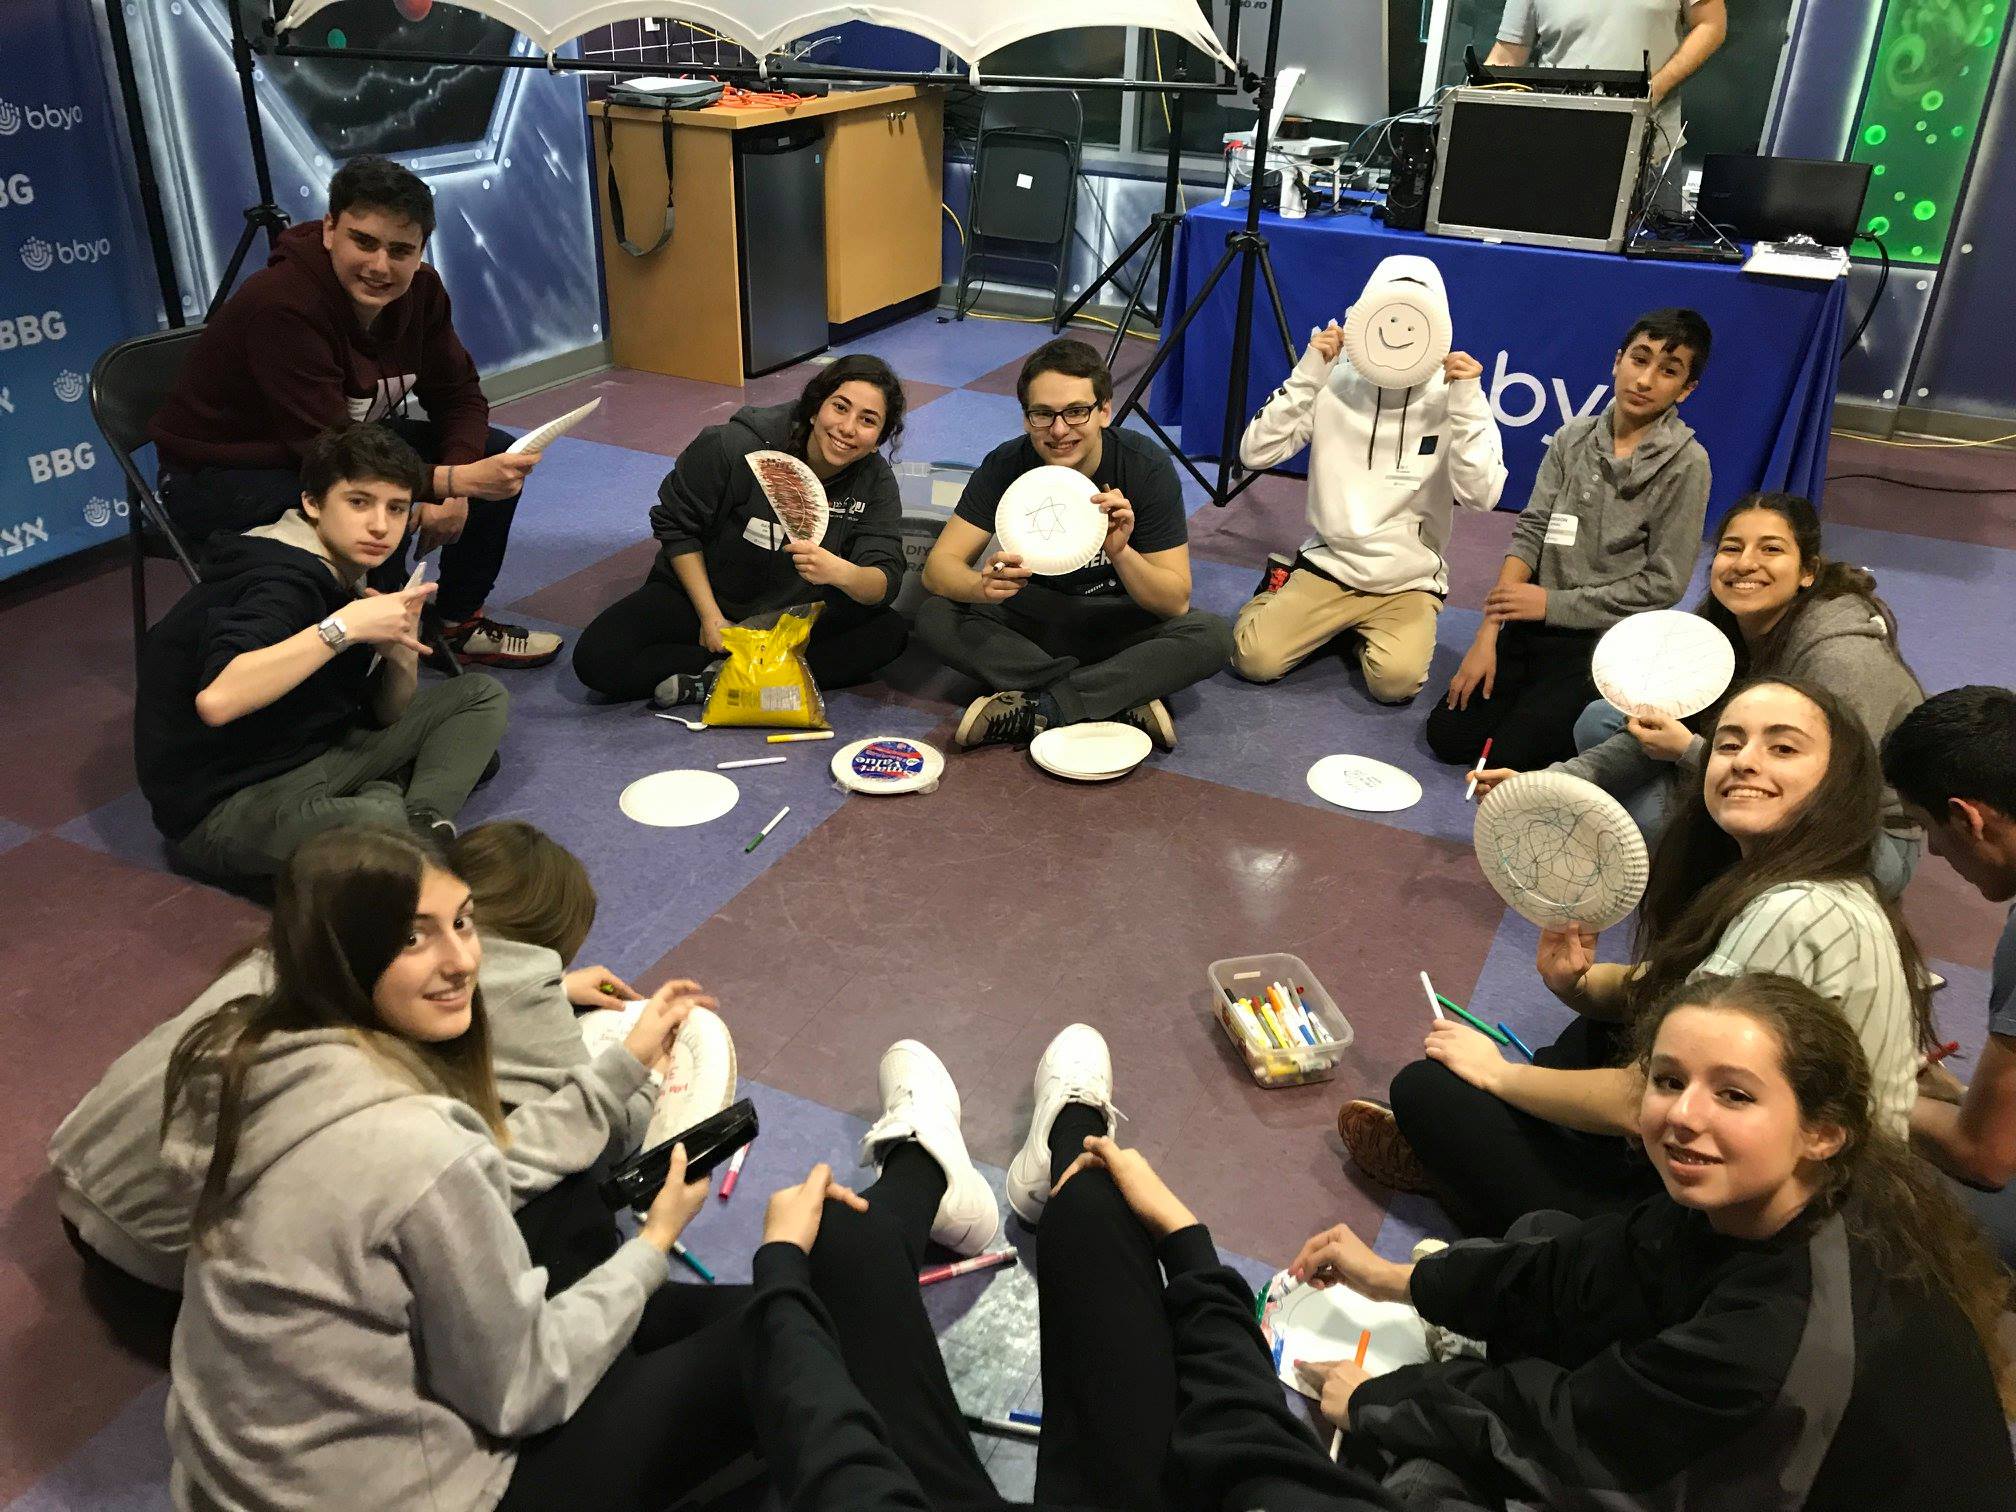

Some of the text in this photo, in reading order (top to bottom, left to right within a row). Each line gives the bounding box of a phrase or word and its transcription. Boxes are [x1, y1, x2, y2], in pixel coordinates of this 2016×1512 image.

[26, 103, 83, 131] bbyo
[56, 238, 110, 264] bbyo
[1489, 350, 1616, 446] by
[27, 442, 96, 484] BBG
[0, 516, 49, 558] אצ
